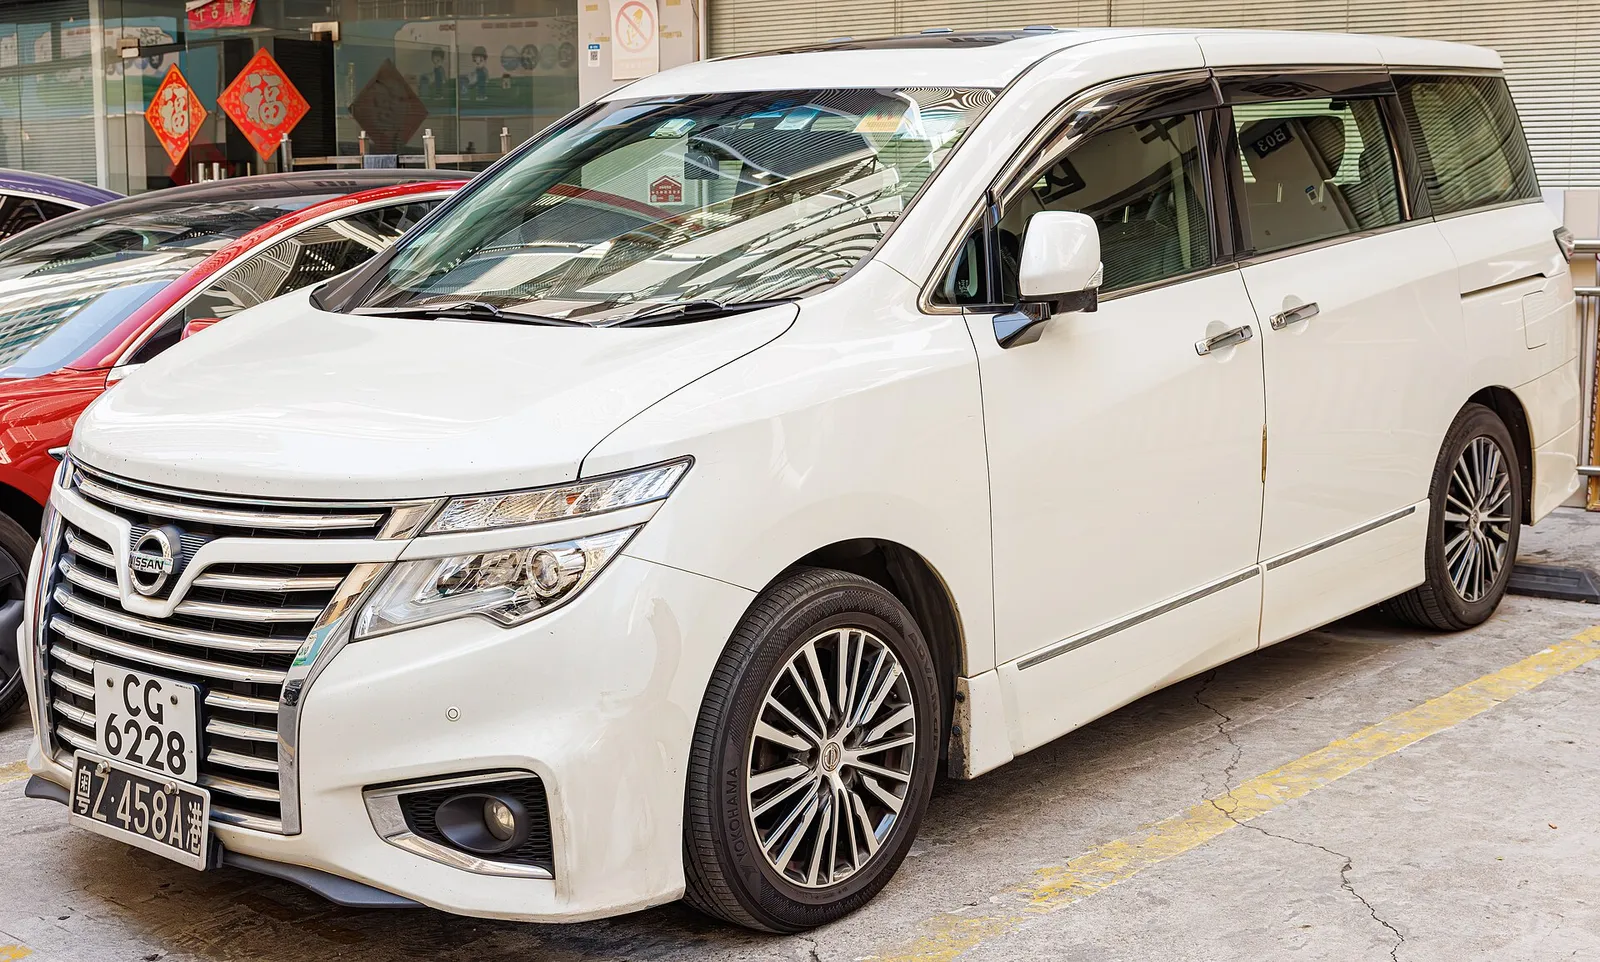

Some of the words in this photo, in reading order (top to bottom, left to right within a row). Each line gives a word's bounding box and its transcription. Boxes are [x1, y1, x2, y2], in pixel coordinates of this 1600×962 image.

[160, 86, 188, 134] 福
[242, 73, 287, 125] 福
[129, 554, 164, 570] NISSAN
[123, 673, 164, 725] CG
[104, 712, 187, 775] 6228
[725, 767, 747, 861] YOKOHAMA
